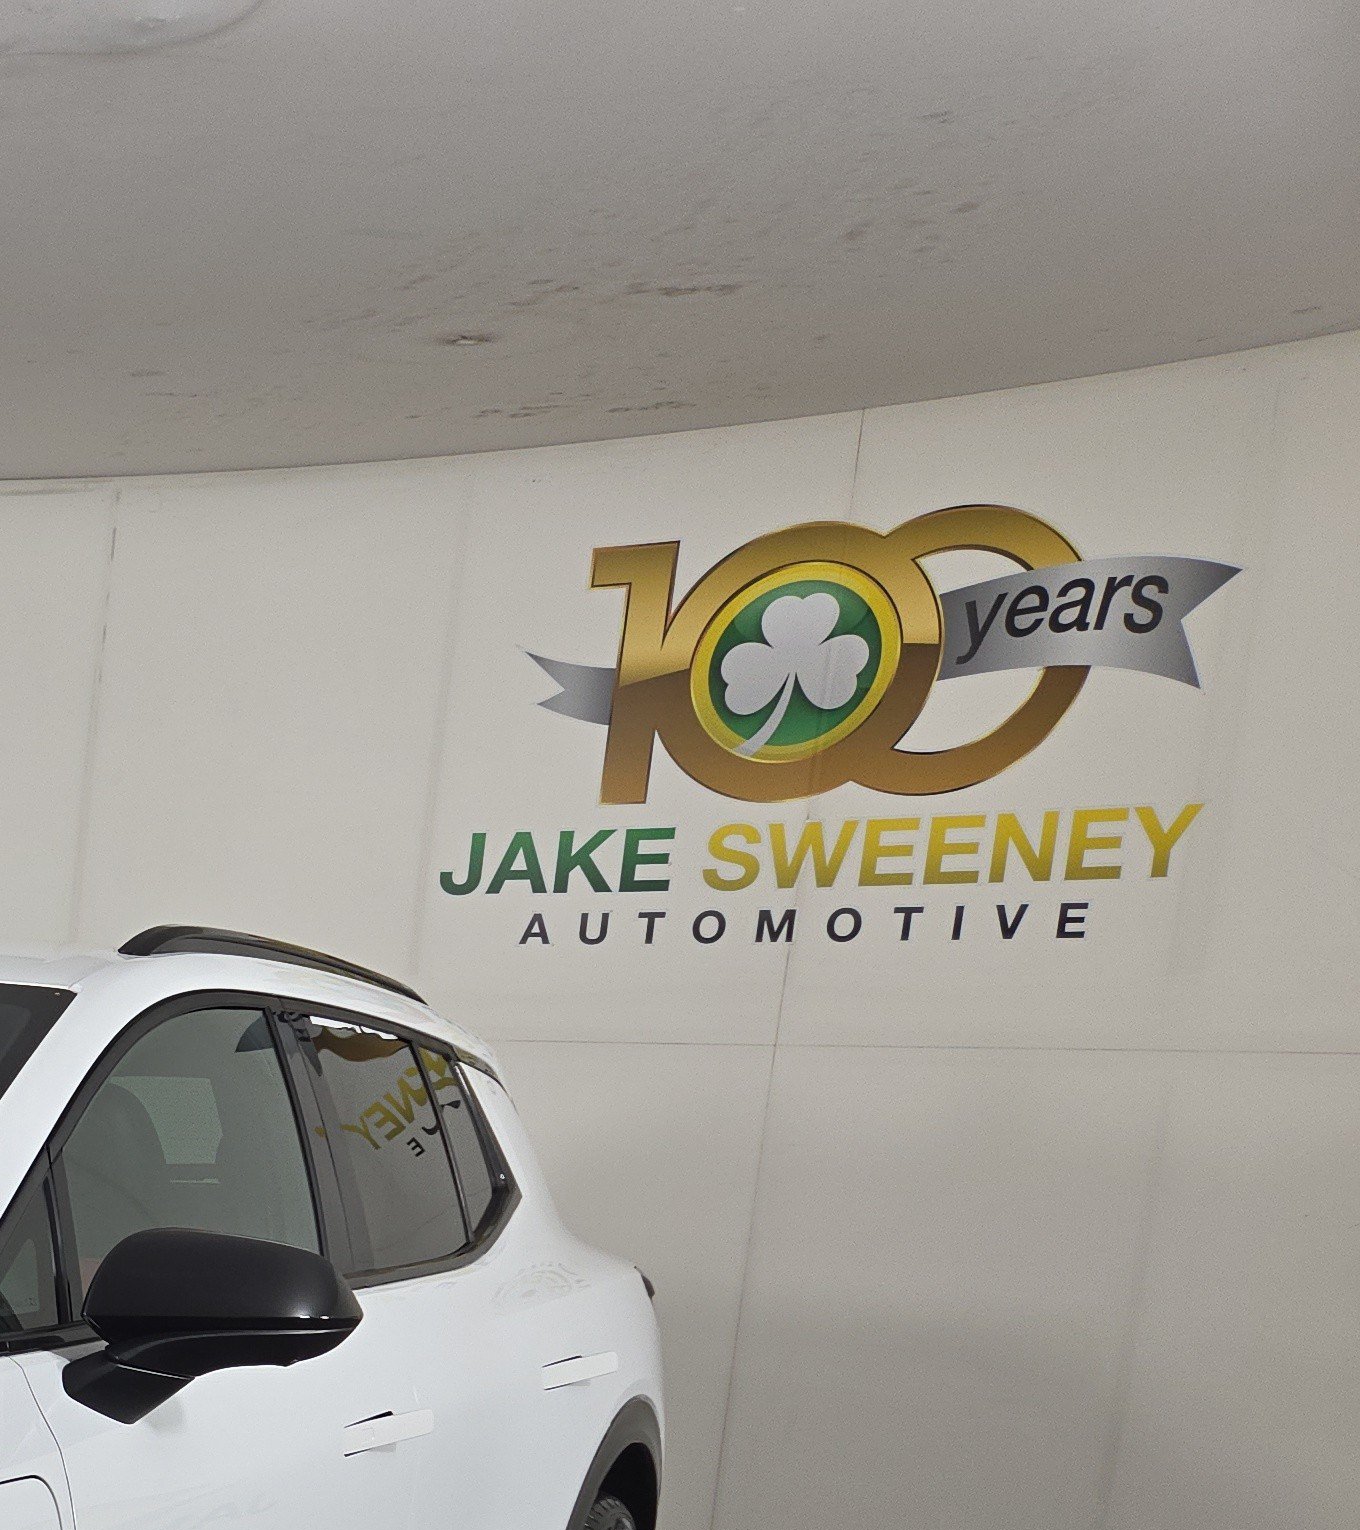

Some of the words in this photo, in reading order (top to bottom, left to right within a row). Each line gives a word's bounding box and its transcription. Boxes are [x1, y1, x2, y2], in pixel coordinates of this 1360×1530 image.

[956, 570, 1168, 666] years
[439, 826, 676, 896] JAKE
[702, 803, 1204, 892] SWEENEY
[520, 901, 1090, 945] AUTOMOTIVE
